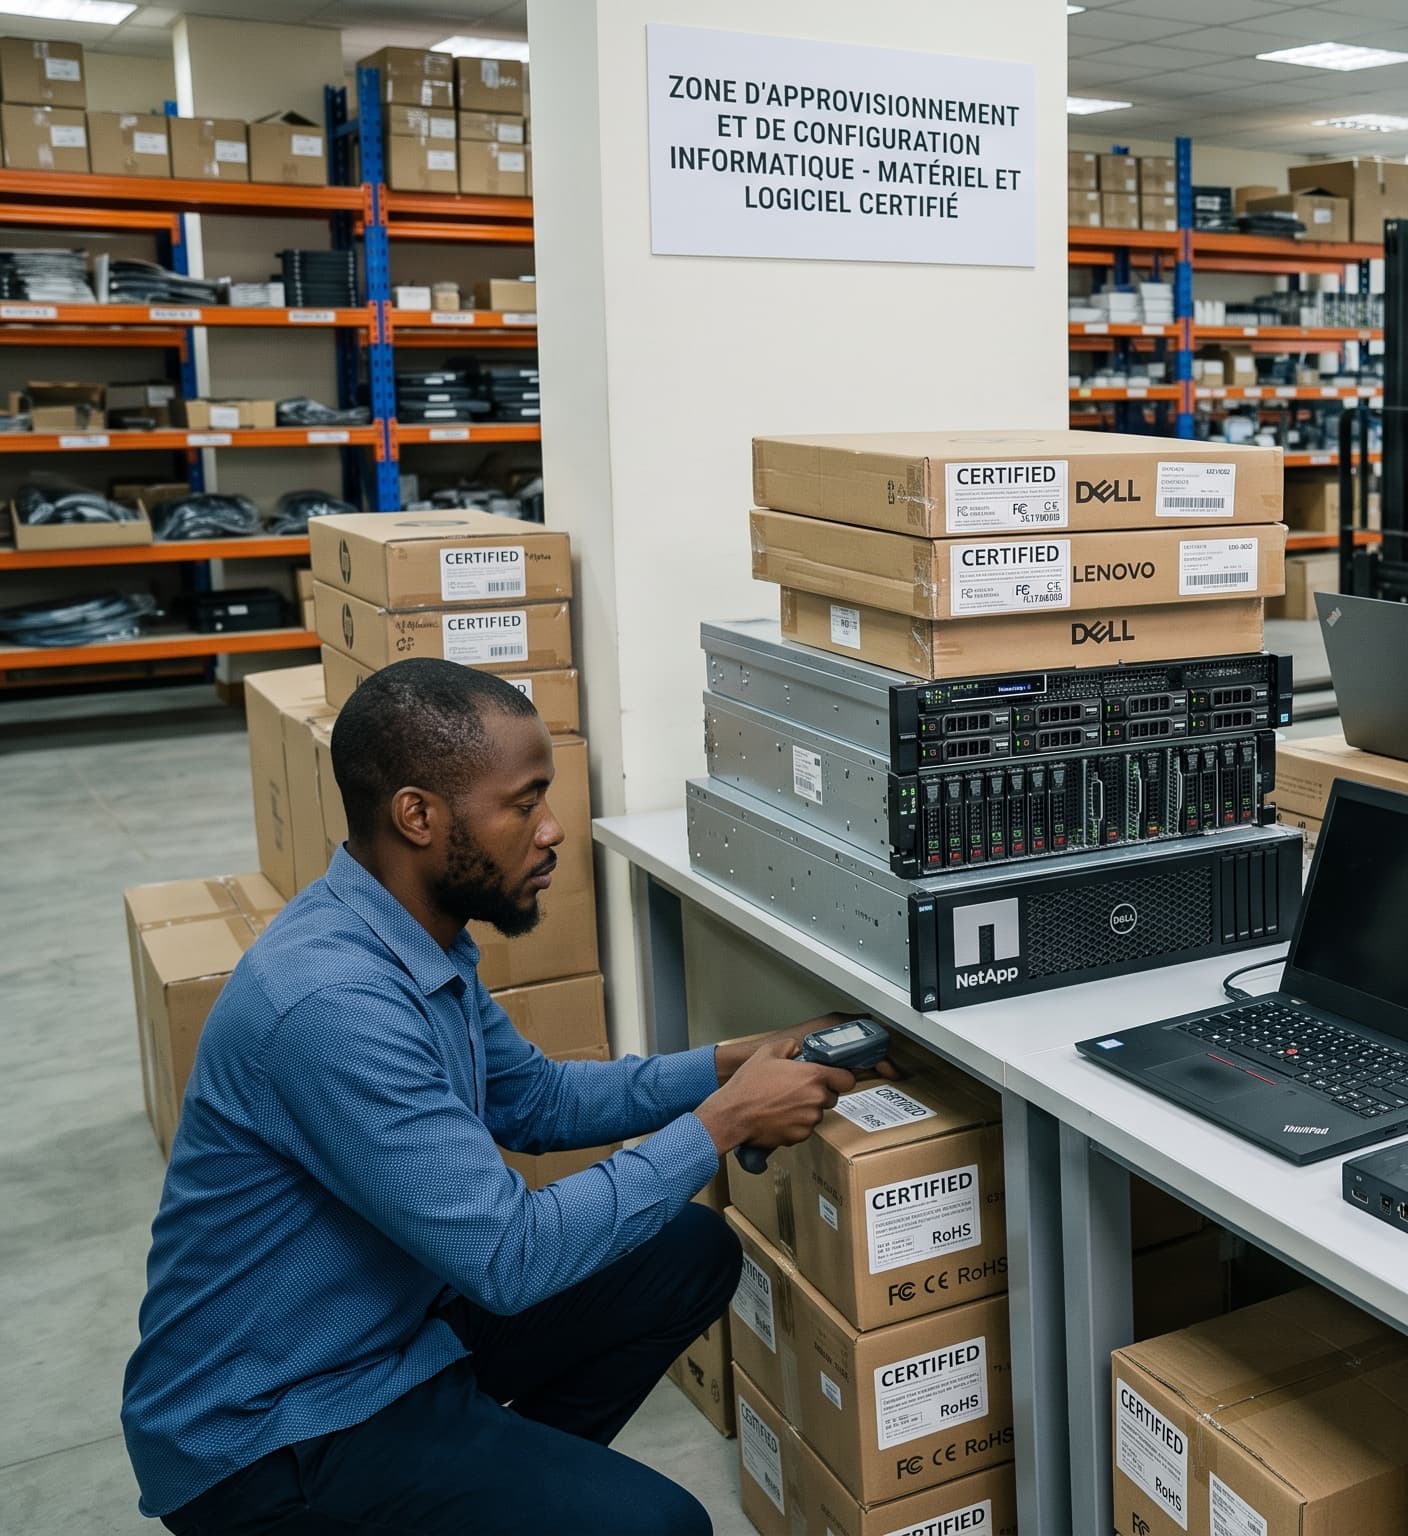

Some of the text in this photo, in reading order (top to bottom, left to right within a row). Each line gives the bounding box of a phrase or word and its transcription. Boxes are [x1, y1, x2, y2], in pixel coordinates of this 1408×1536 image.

[668, 74, 1020, 128] ZONE D'APPROVISIONNEMENT
[717, 114, 980, 156] ET DE CONFIGURATION
[670, 146, 855, 182] INFORMATIQUE
[878, 158, 989, 190] MATÉRIEL
[995, 169, 1021, 191] ET
[744, 185, 959, 219] LOGICIEL CERTIFIÉ
[956, 466, 1056, 485] CERTIFIED
[1075, 479, 1142, 504] DELL
[445, 551, 519, 565] CERTIFIED
[962, 545, 1060, 566] CERTIFIED
[1072, 562, 1155, 583] LENOVO
[447, 615, 521, 631] CERTIFIED
[1072, 619, 1135, 645] DELL
[955, 966, 1019, 990] NetApp
[872, 1172, 973, 1210] CERTIFIED
[932, 1223, 971, 1244] RoHS
[924, 1271, 949, 1293] CE
[958, 1257, 1008, 1285] RoHS
[881, 1345, 980, 1387] CERTIFIED
[940, 1395, 979, 1418] RoHS
[1121, 1389, 1183, 1455] CERTIFIED
[932, 1444, 956, 1466] CE
[965, 1427, 1014, 1457] RoHS
[1155, 1476, 1182, 1512] RoHS
